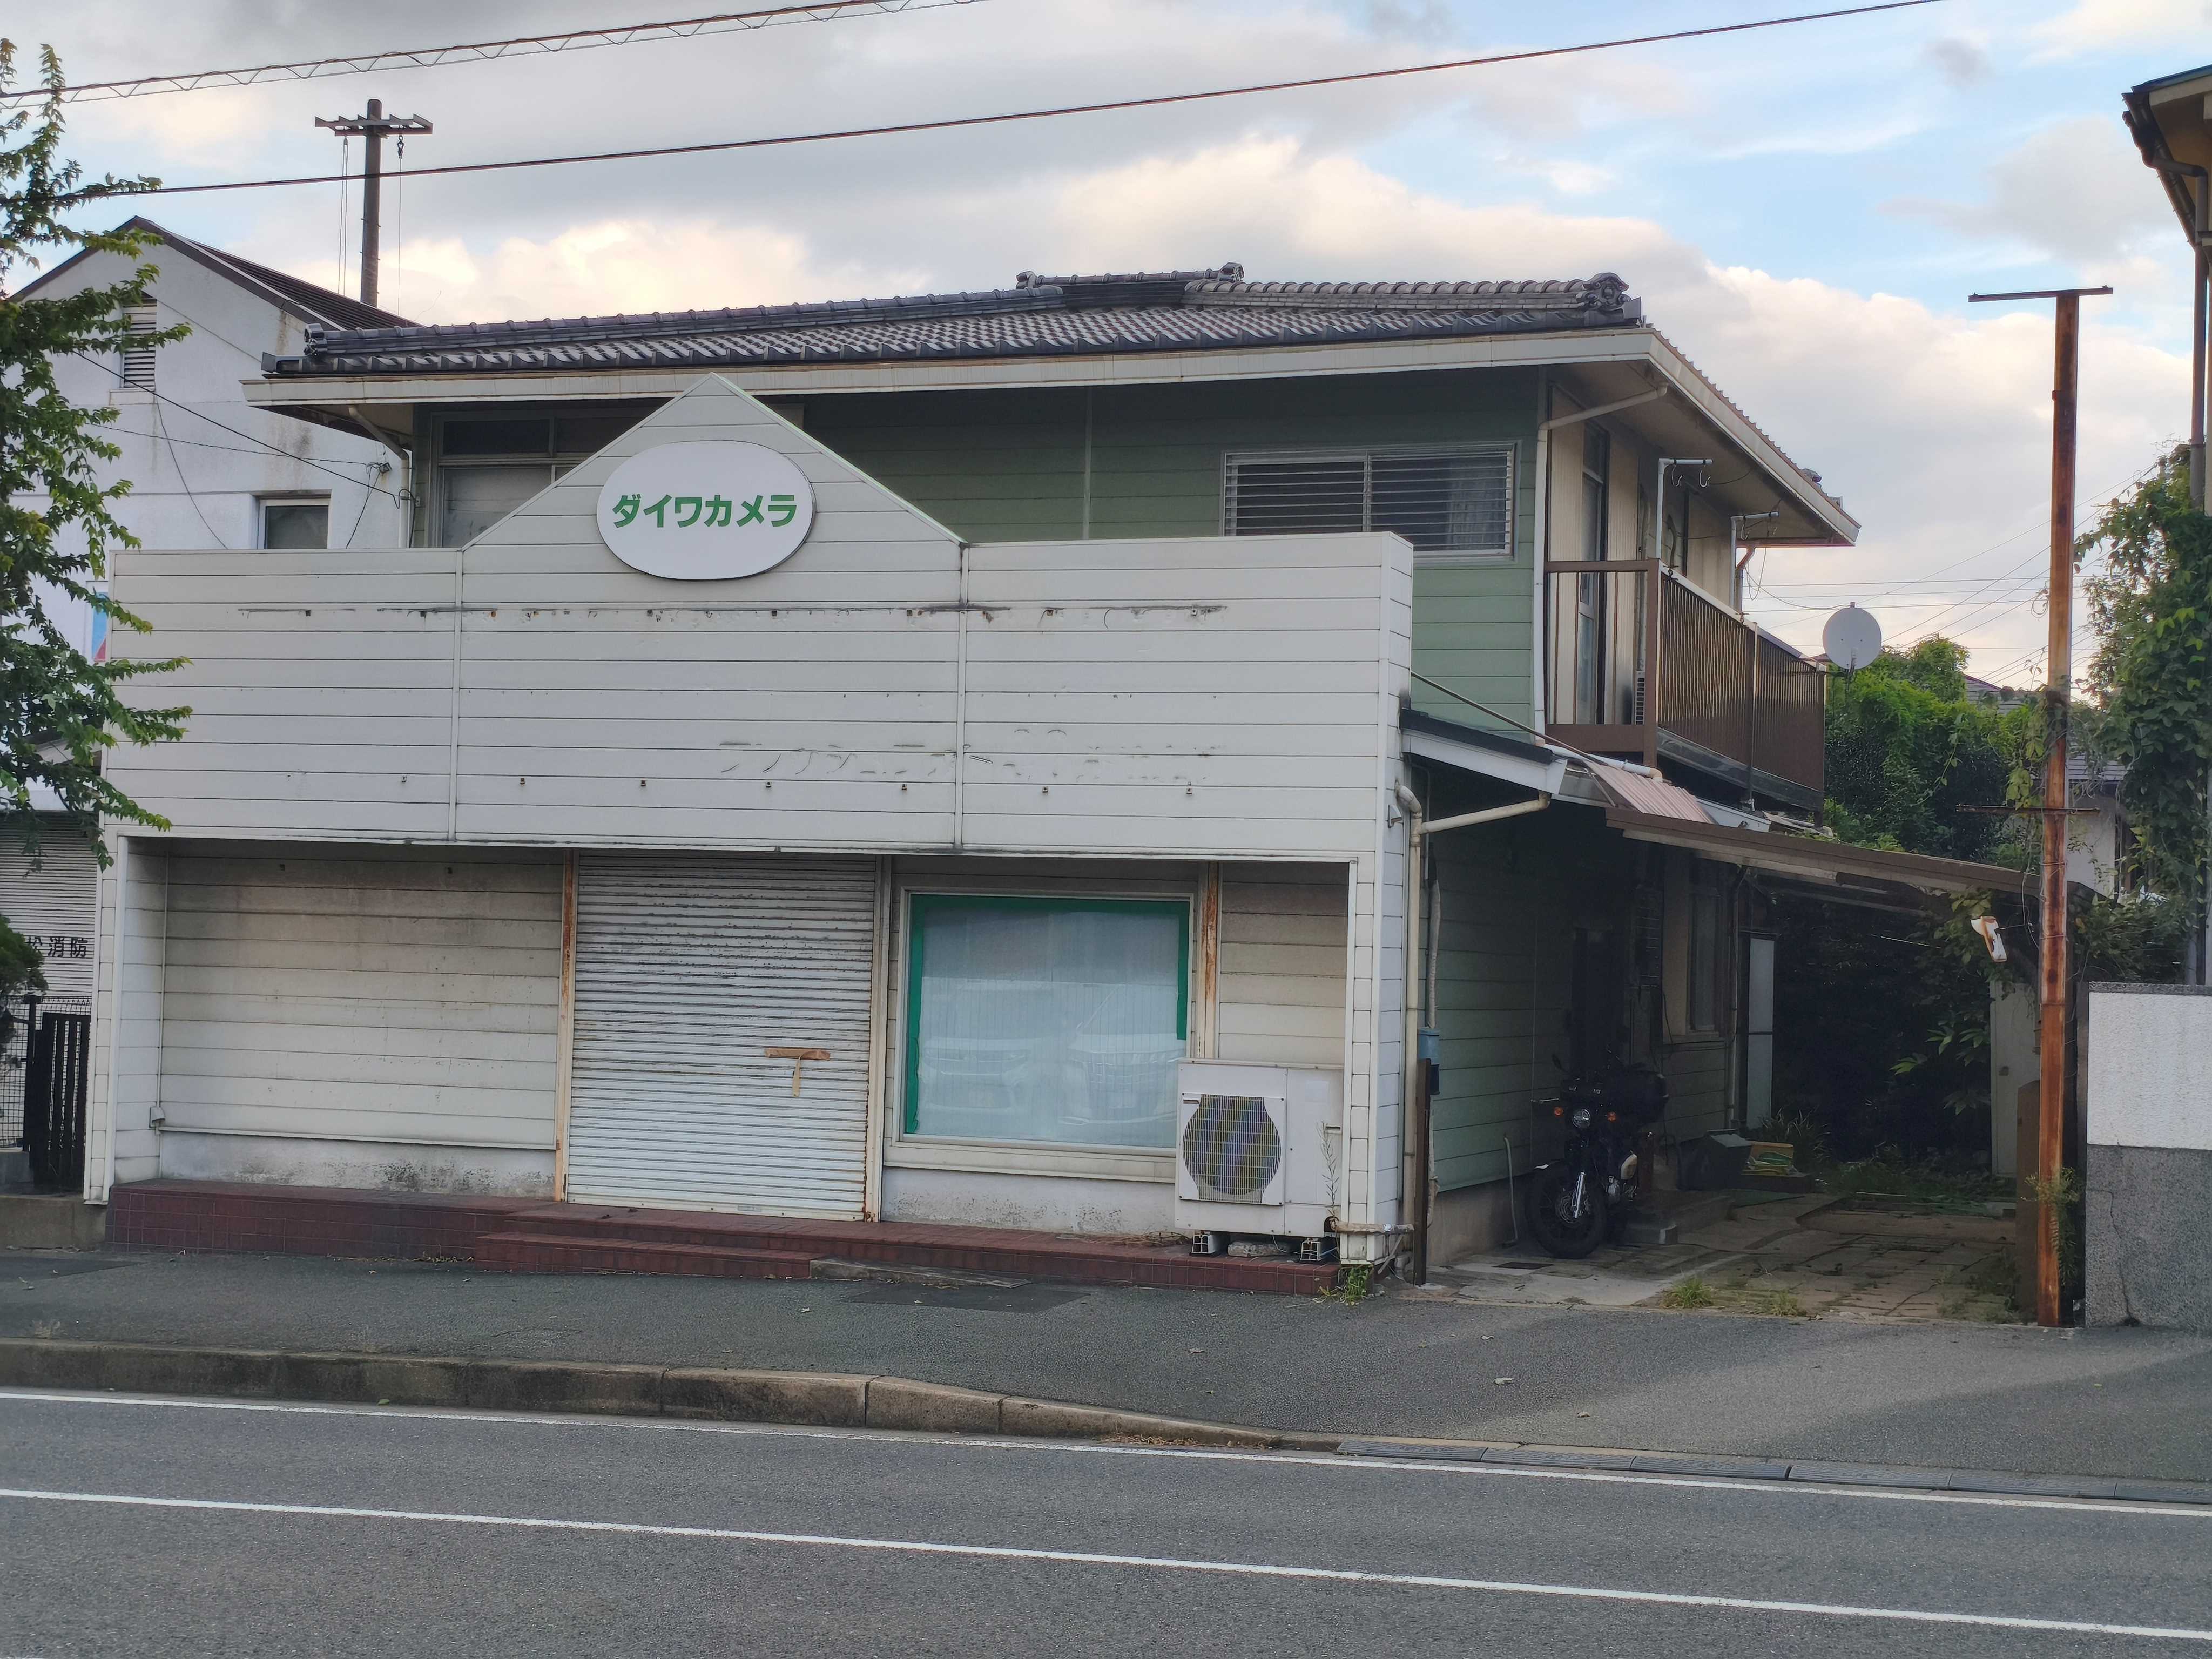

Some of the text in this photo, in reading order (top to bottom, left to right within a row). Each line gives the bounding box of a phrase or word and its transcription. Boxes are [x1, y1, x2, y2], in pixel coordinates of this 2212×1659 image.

[612, 494, 797, 528] ダイワカメラ
